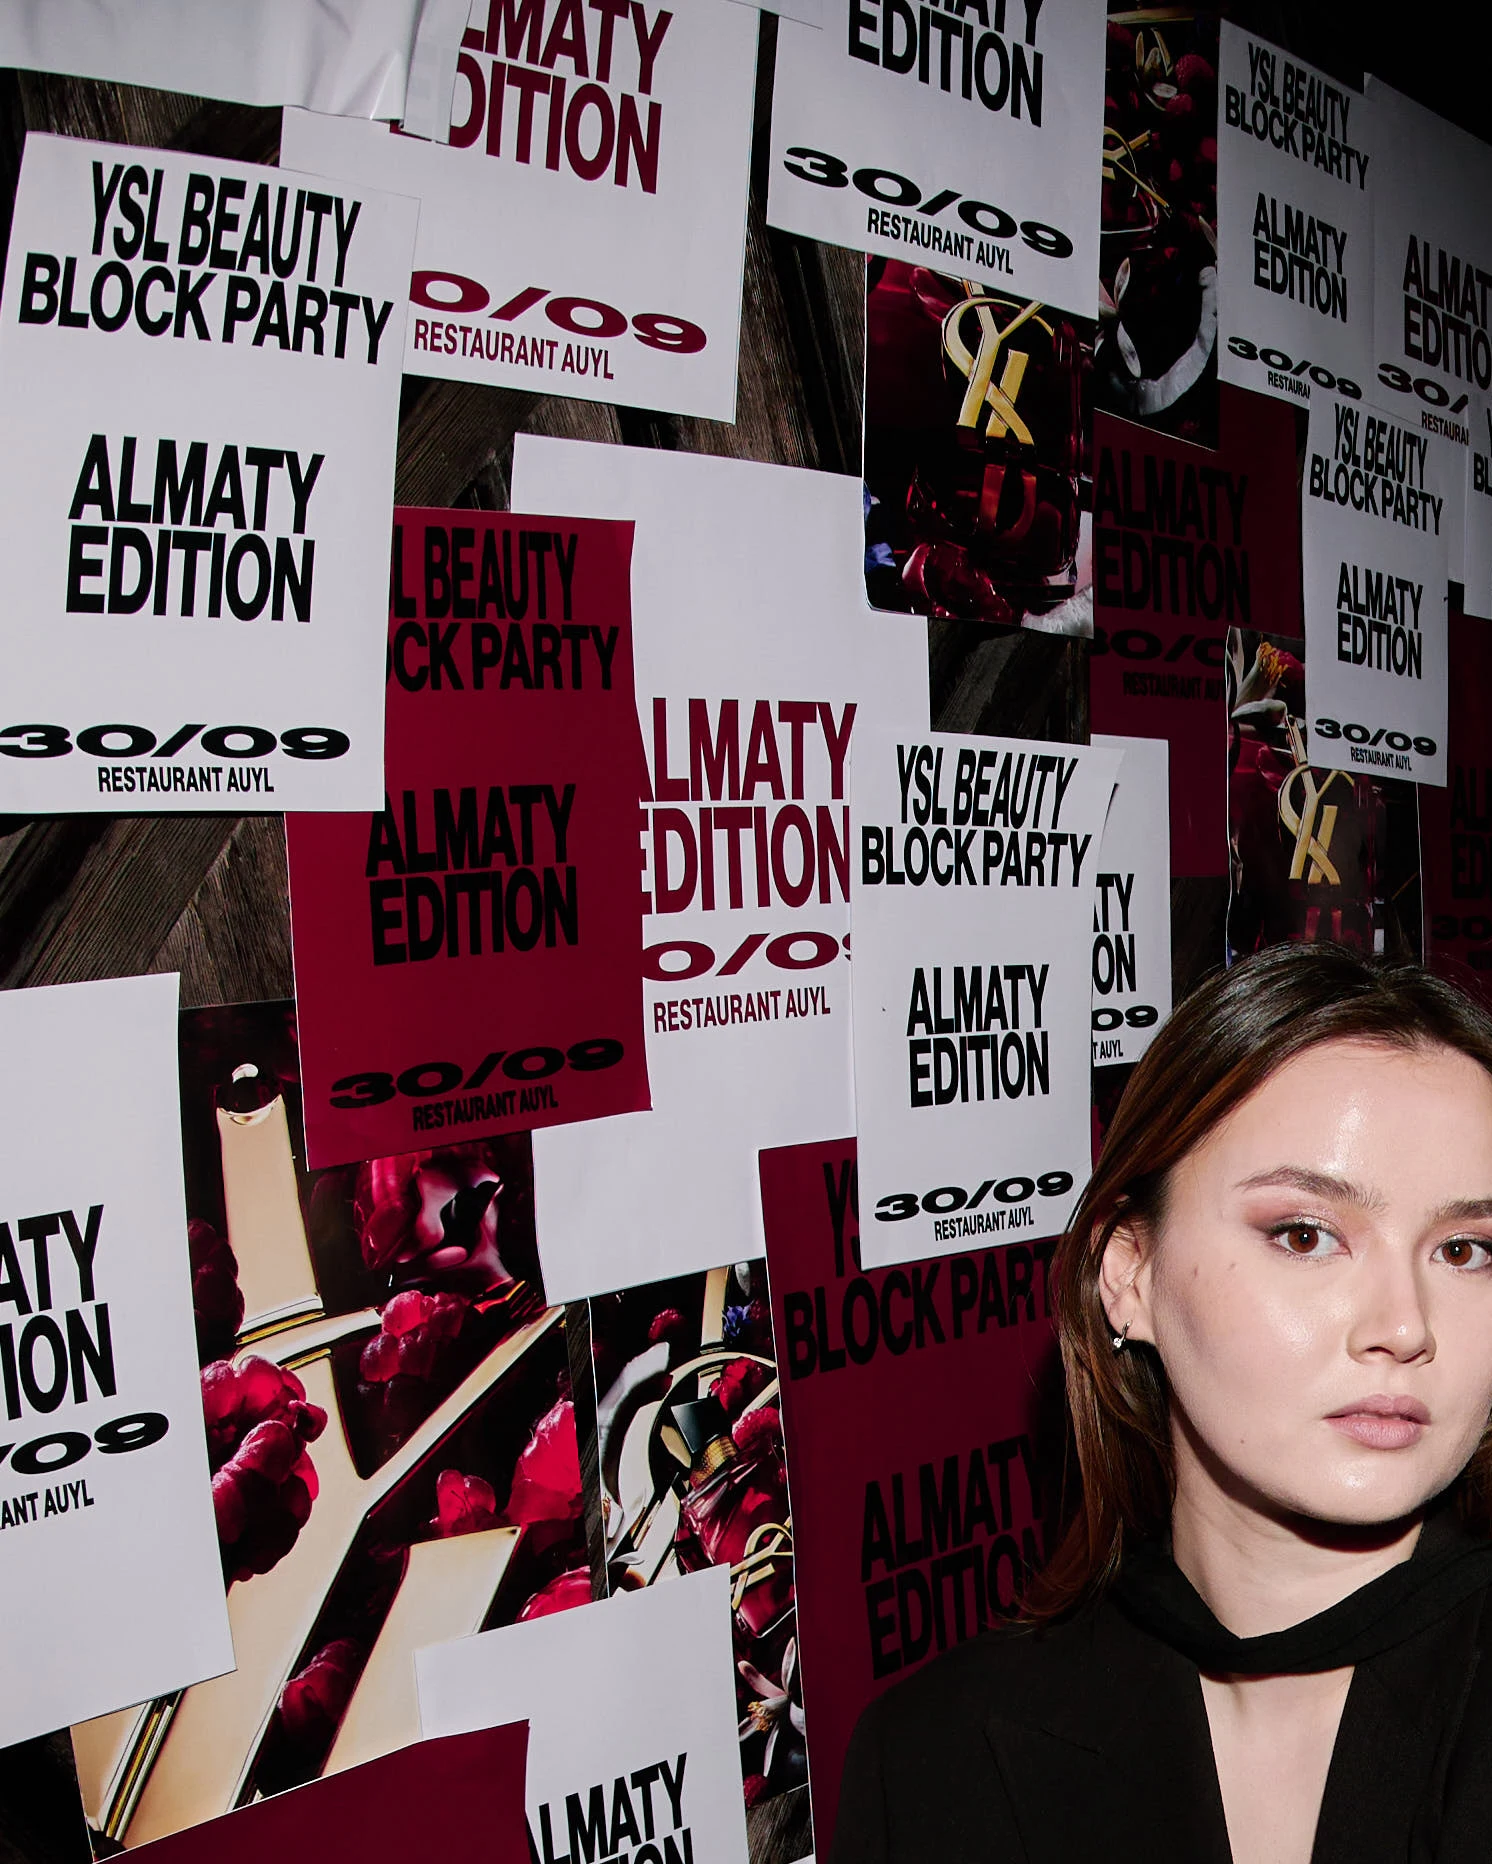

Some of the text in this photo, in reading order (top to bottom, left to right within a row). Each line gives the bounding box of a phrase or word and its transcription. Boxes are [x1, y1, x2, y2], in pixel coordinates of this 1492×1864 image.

[461, 0, 673, 95] MATY
[848, 0, 1043, 127] EDITION
[449, 53, 662, 195] DITION
[1248, 42, 1350, 143] YSL BEAUTY
[1225, 85, 1369, 190] BLOCK PARTY
[91, 161, 361, 287] YSL BEAUTY
[783, 146, 1074, 259] 30/09
[867, 208, 1014, 275] RESTAURANT AUYL
[1253, 192, 1347, 275] ALMATY
[19, 253, 393, 364] BLOCK PARTY
[409, 270, 707, 354] 0/09
[1254, 242, 1347, 323] EDITION
[414, 319, 614, 380] RESTAURANT AUYL
[1227, 336, 1362, 400] 30/09
[1268, 370, 1310, 400] RESTAURA
[1377, 362, 1468, 414] 30/
[68, 434, 324, 534] ALMATY
[1334, 403, 1428, 490] YSL BEAUTY
[1096, 447, 1248, 546] ALMATY
[1309, 454, 1443, 535] BLOCK PARTY
[66, 525, 314, 623] EDITION
[424, 525, 577, 618] BEAUTY
[1099, 529, 1251, 623] EDITION
[1337, 562, 1423, 630] ALMATY
[473, 625, 619, 691] PARTY
[1337, 610, 1422, 680] EDITION
[0, 723, 350, 760] 30/09
[652, 697, 857, 802] LMATY
[1315, 718, 1437, 756] 30/09
[1350, 747, 1394, 768] RESTAURANT
[98, 767, 274, 792] RESTAURANT AUYL
[897, 744, 1078, 830] YSL BEAUTY
[365, 784, 576, 877] ALMATY
[640, 804, 850, 915] DITION
[861, 826, 1092, 887] BLOCK PARTY
[371, 866, 579, 966] EDITION
[654, 986, 831, 1033] RESTAURANT AUYL
[907, 964, 1049, 1037] ALMATY
[328, 1037, 625, 1109] 30/09
[910, 1031, 1050, 1108] EDITION
[1100, 1039, 1124, 1059] AUYL
[412, 1084, 559, 1131] RESTAURANT AUYL
[874, 1170, 1073, 1223] 30/09
[934, 1205, 1035, 1242] RESTAURANT AUYL
[0, 1204, 104, 1316] ATY
[784, 1262, 946, 1381] BLOCK
[44, 1479, 95, 1518] AUYL
